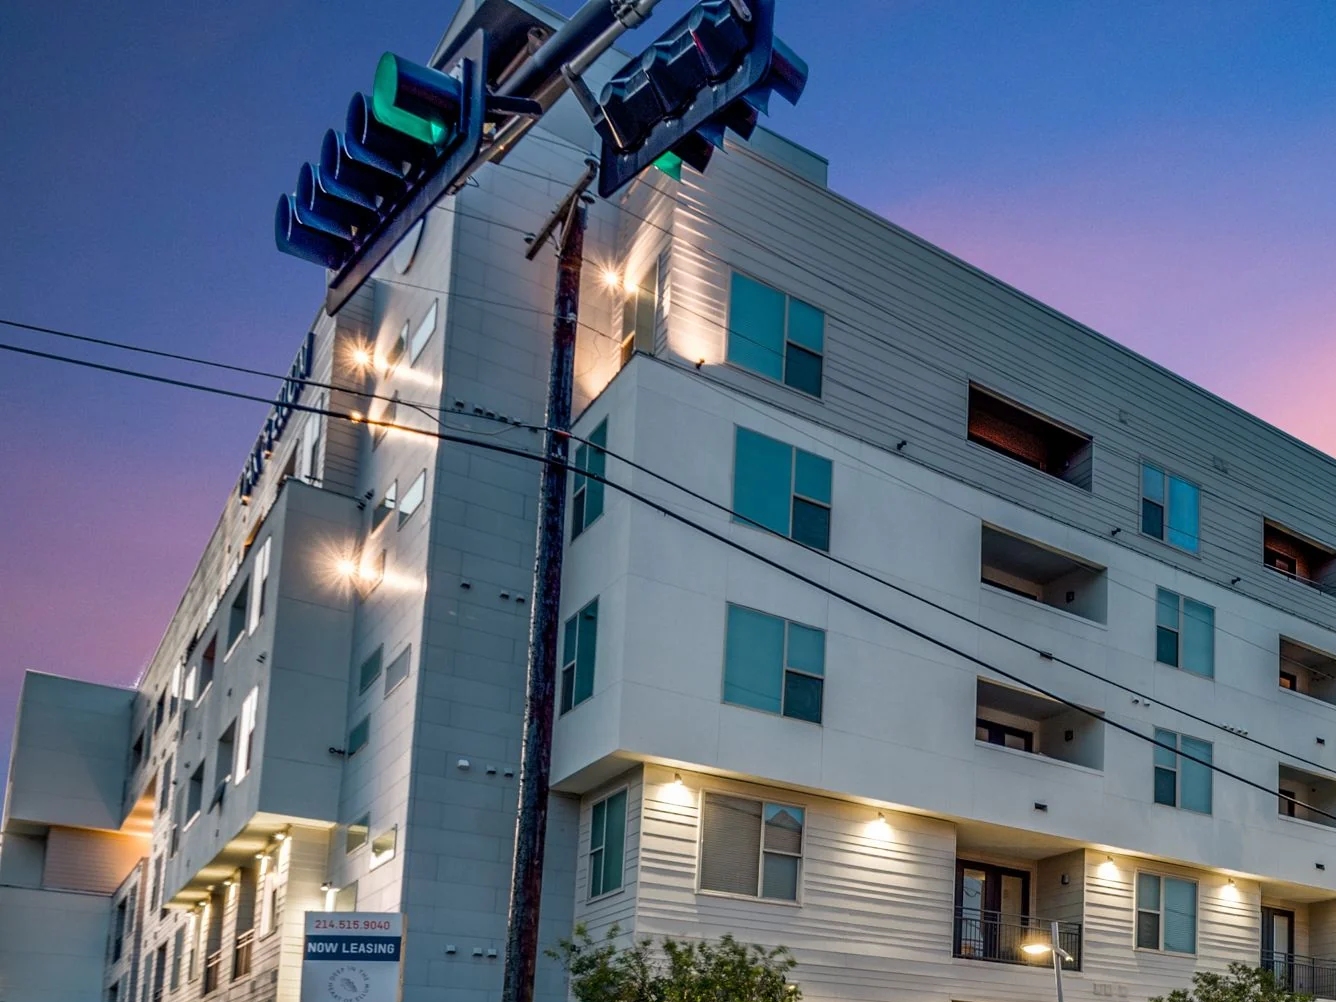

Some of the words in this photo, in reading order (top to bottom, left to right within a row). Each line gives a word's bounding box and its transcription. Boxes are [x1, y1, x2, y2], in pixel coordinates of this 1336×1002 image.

[315, 919, 390, 930] 214.515.9040
[307, 942, 338, 953] NOW
[342, 942, 395, 954] LEASING
